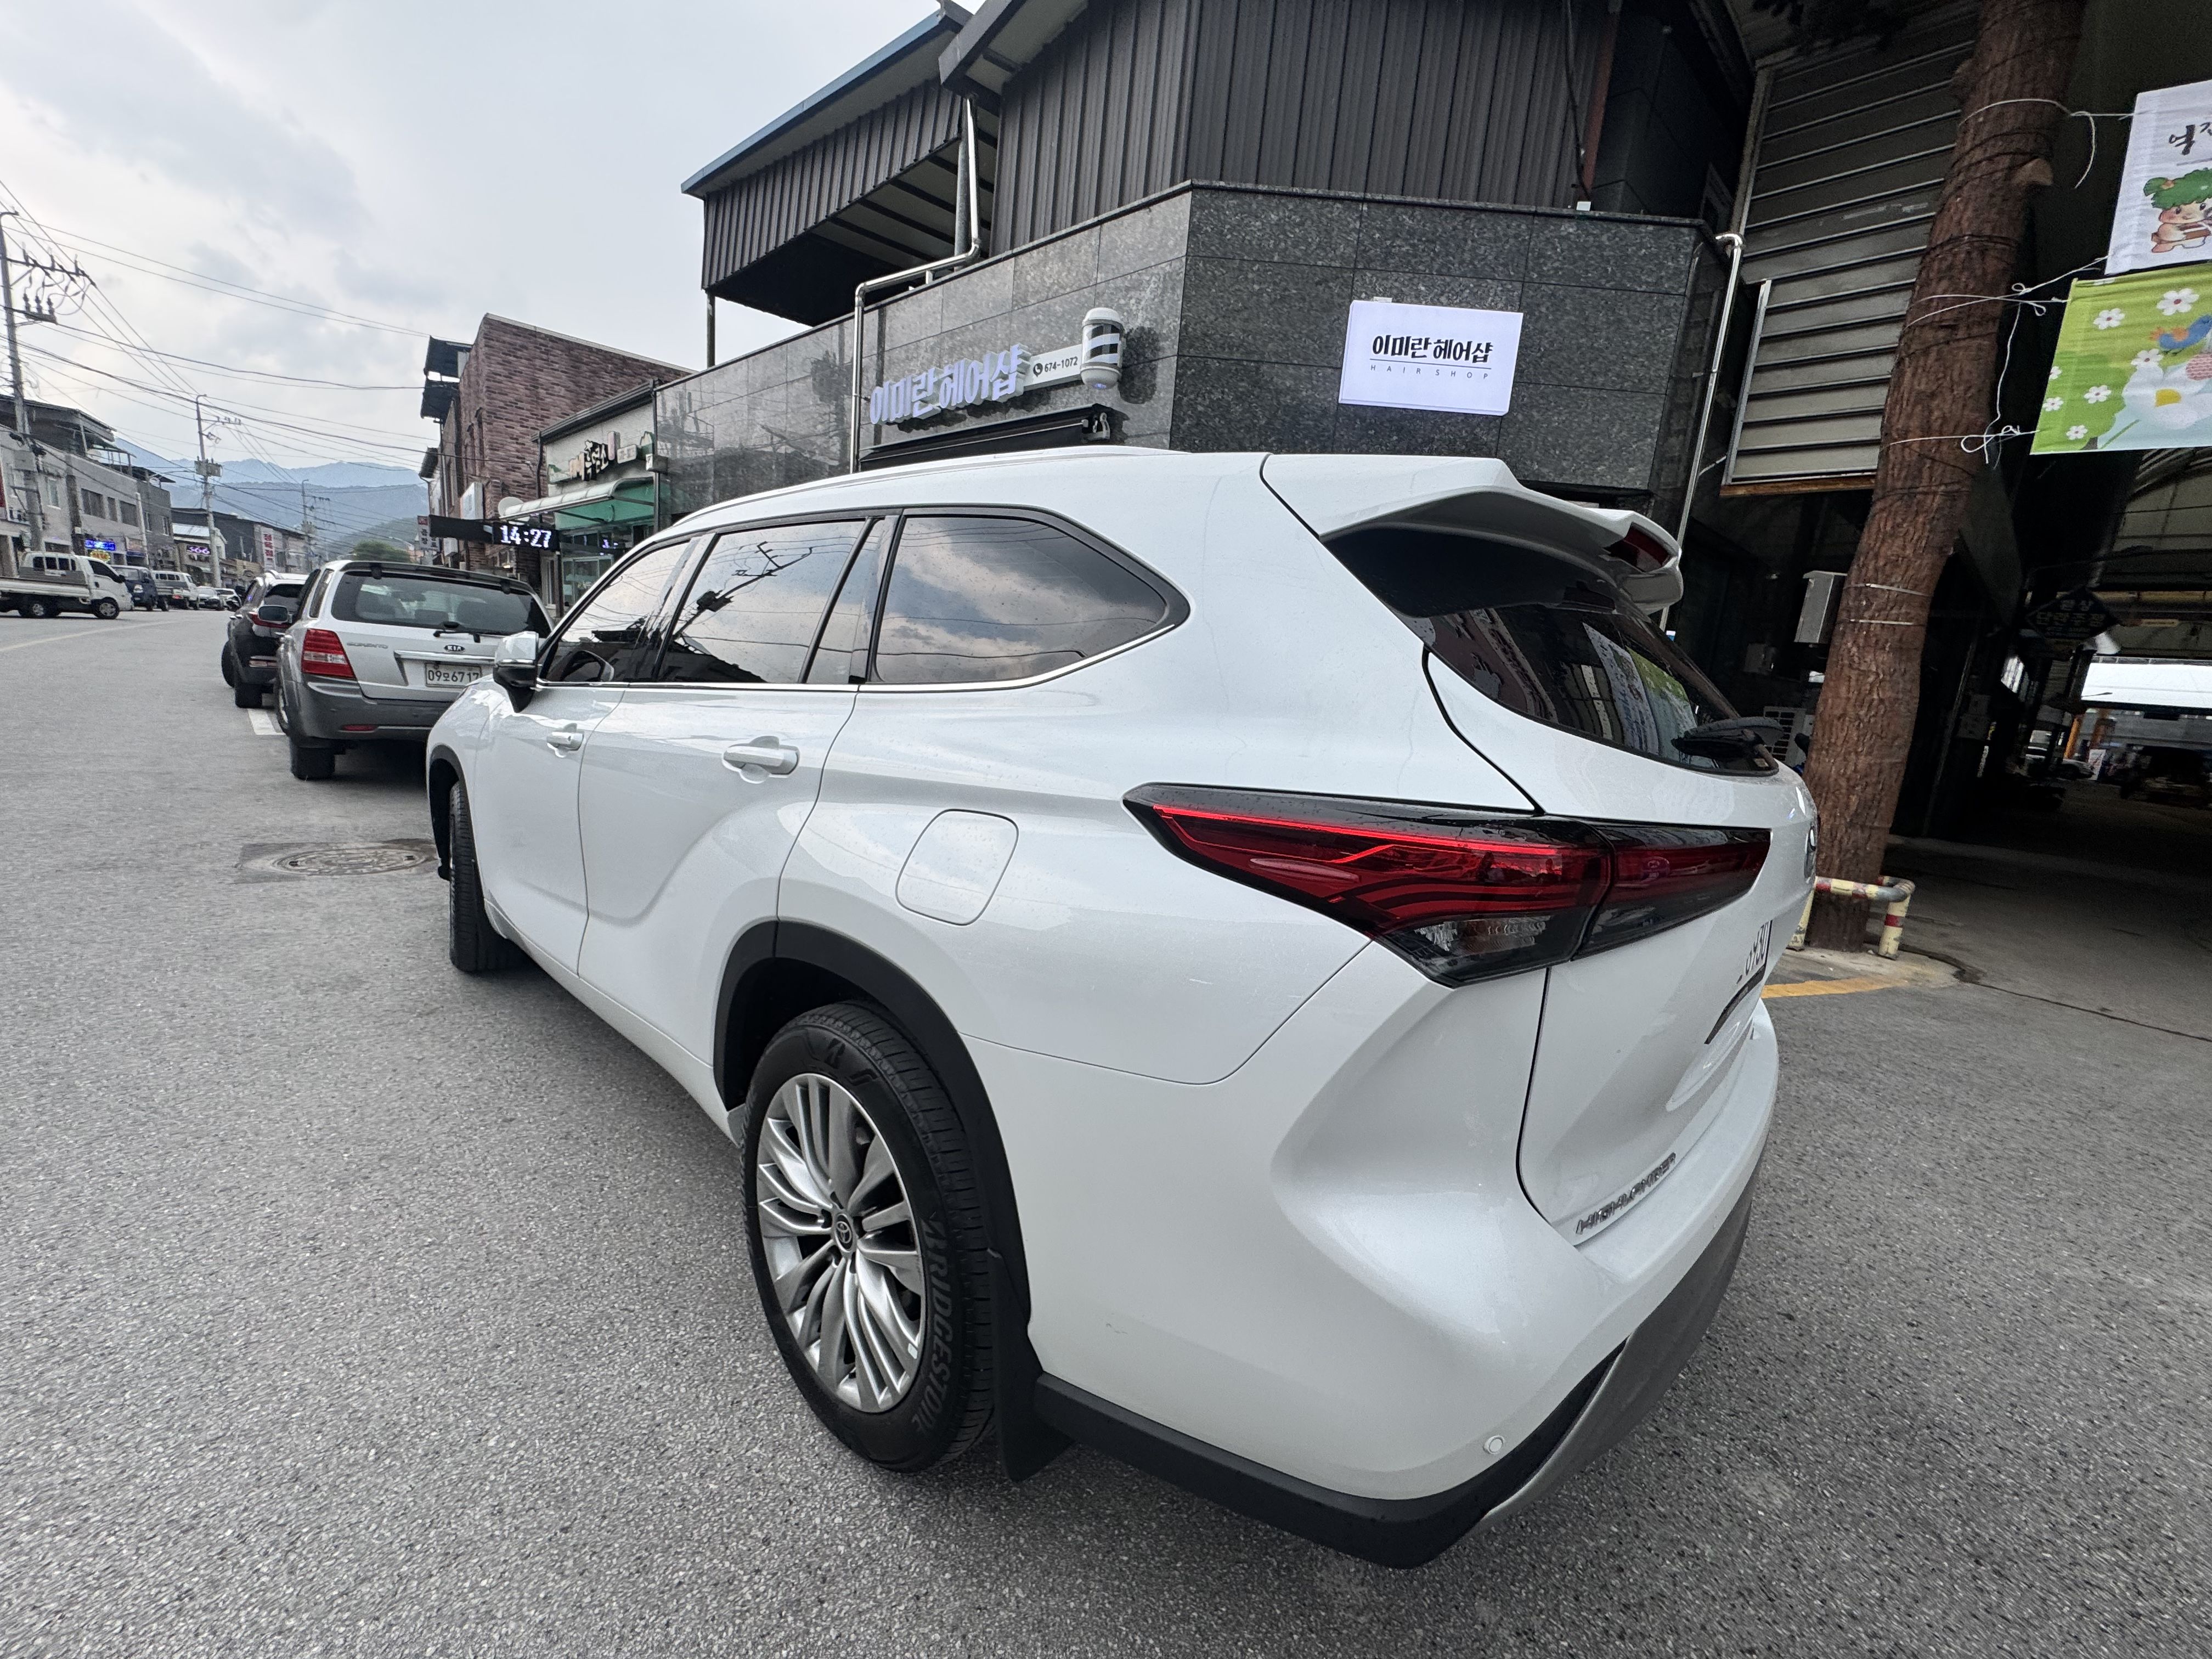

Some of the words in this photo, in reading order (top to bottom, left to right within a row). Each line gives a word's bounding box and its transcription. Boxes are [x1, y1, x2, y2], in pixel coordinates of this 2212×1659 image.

[1373, 335, 1432, 358] 이미란
[1433, 339, 1493, 363] 헤어샵
[1044, 357, 1077, 372] 674-1072
[1370, 365, 1421, 374] HAIR
[1435, 369, 1488, 379] SHOP
[870, 367, 938, 425] 이미란
[939, 343, 1023, 409] 헤어샵
[500, 525, 551, 548] 14:27
[428, 669, 480, 682] 09모6717
